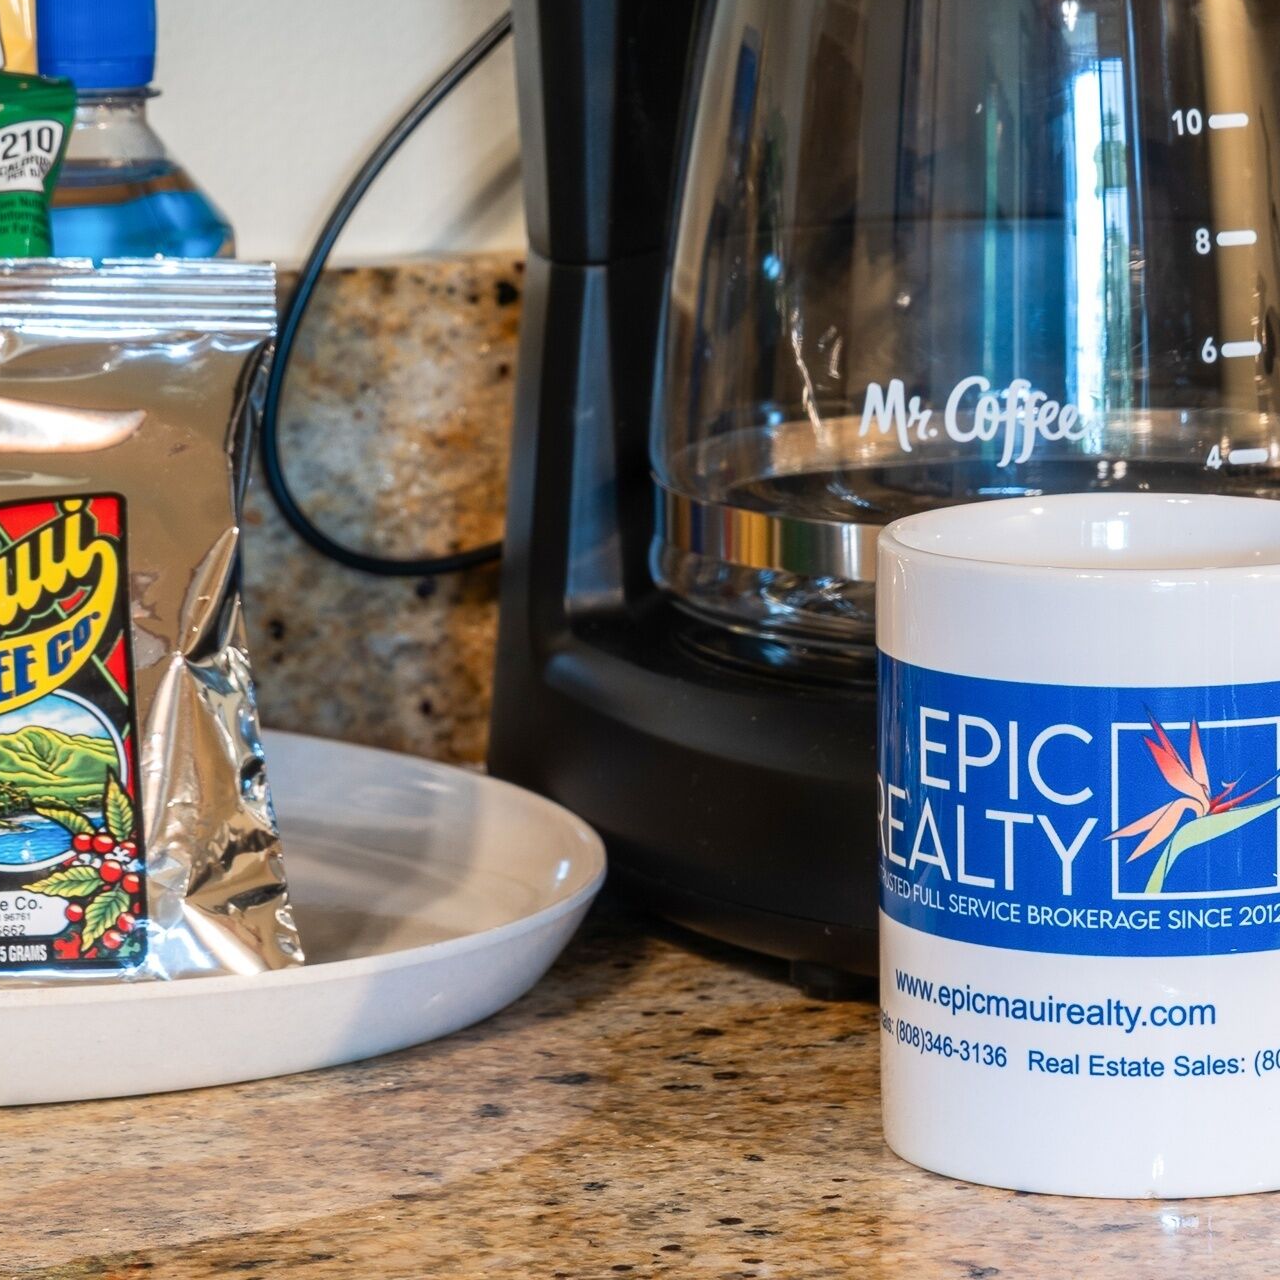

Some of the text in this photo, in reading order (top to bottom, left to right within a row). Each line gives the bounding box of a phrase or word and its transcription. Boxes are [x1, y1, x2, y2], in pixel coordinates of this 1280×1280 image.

[1172, 110, 1202, 135] 10
[1, 127, 53, 160] 210
[1195, 228, 1211, 254] 8
[1201, 338, 1217, 363] 6
[859, 376, 1093, 468] Mr. Coffee
[1206, 445, 1221, 469] 4
[920, 705, 1094, 806] EPIC
[15, 896, 43, 910] Co.
[913, 886, 945, 911] FULL
[949, 894, 1021, 923] SERVICE
[1027, 905, 1161, 930] BROKERAGE
[1168, 907, 1232, 929] SINCE
[8, 945, 48, 962] GRAMS
[895, 968, 1216, 1033] www.epicmauirealty.com
[896, 1018, 1007, 1068] (808)346-3136
[1027, 1050, 1080, 1076] Real
[1089, 1054, 1165, 1078] Estate
[1173, 1051, 1246, 1078] Sales:
